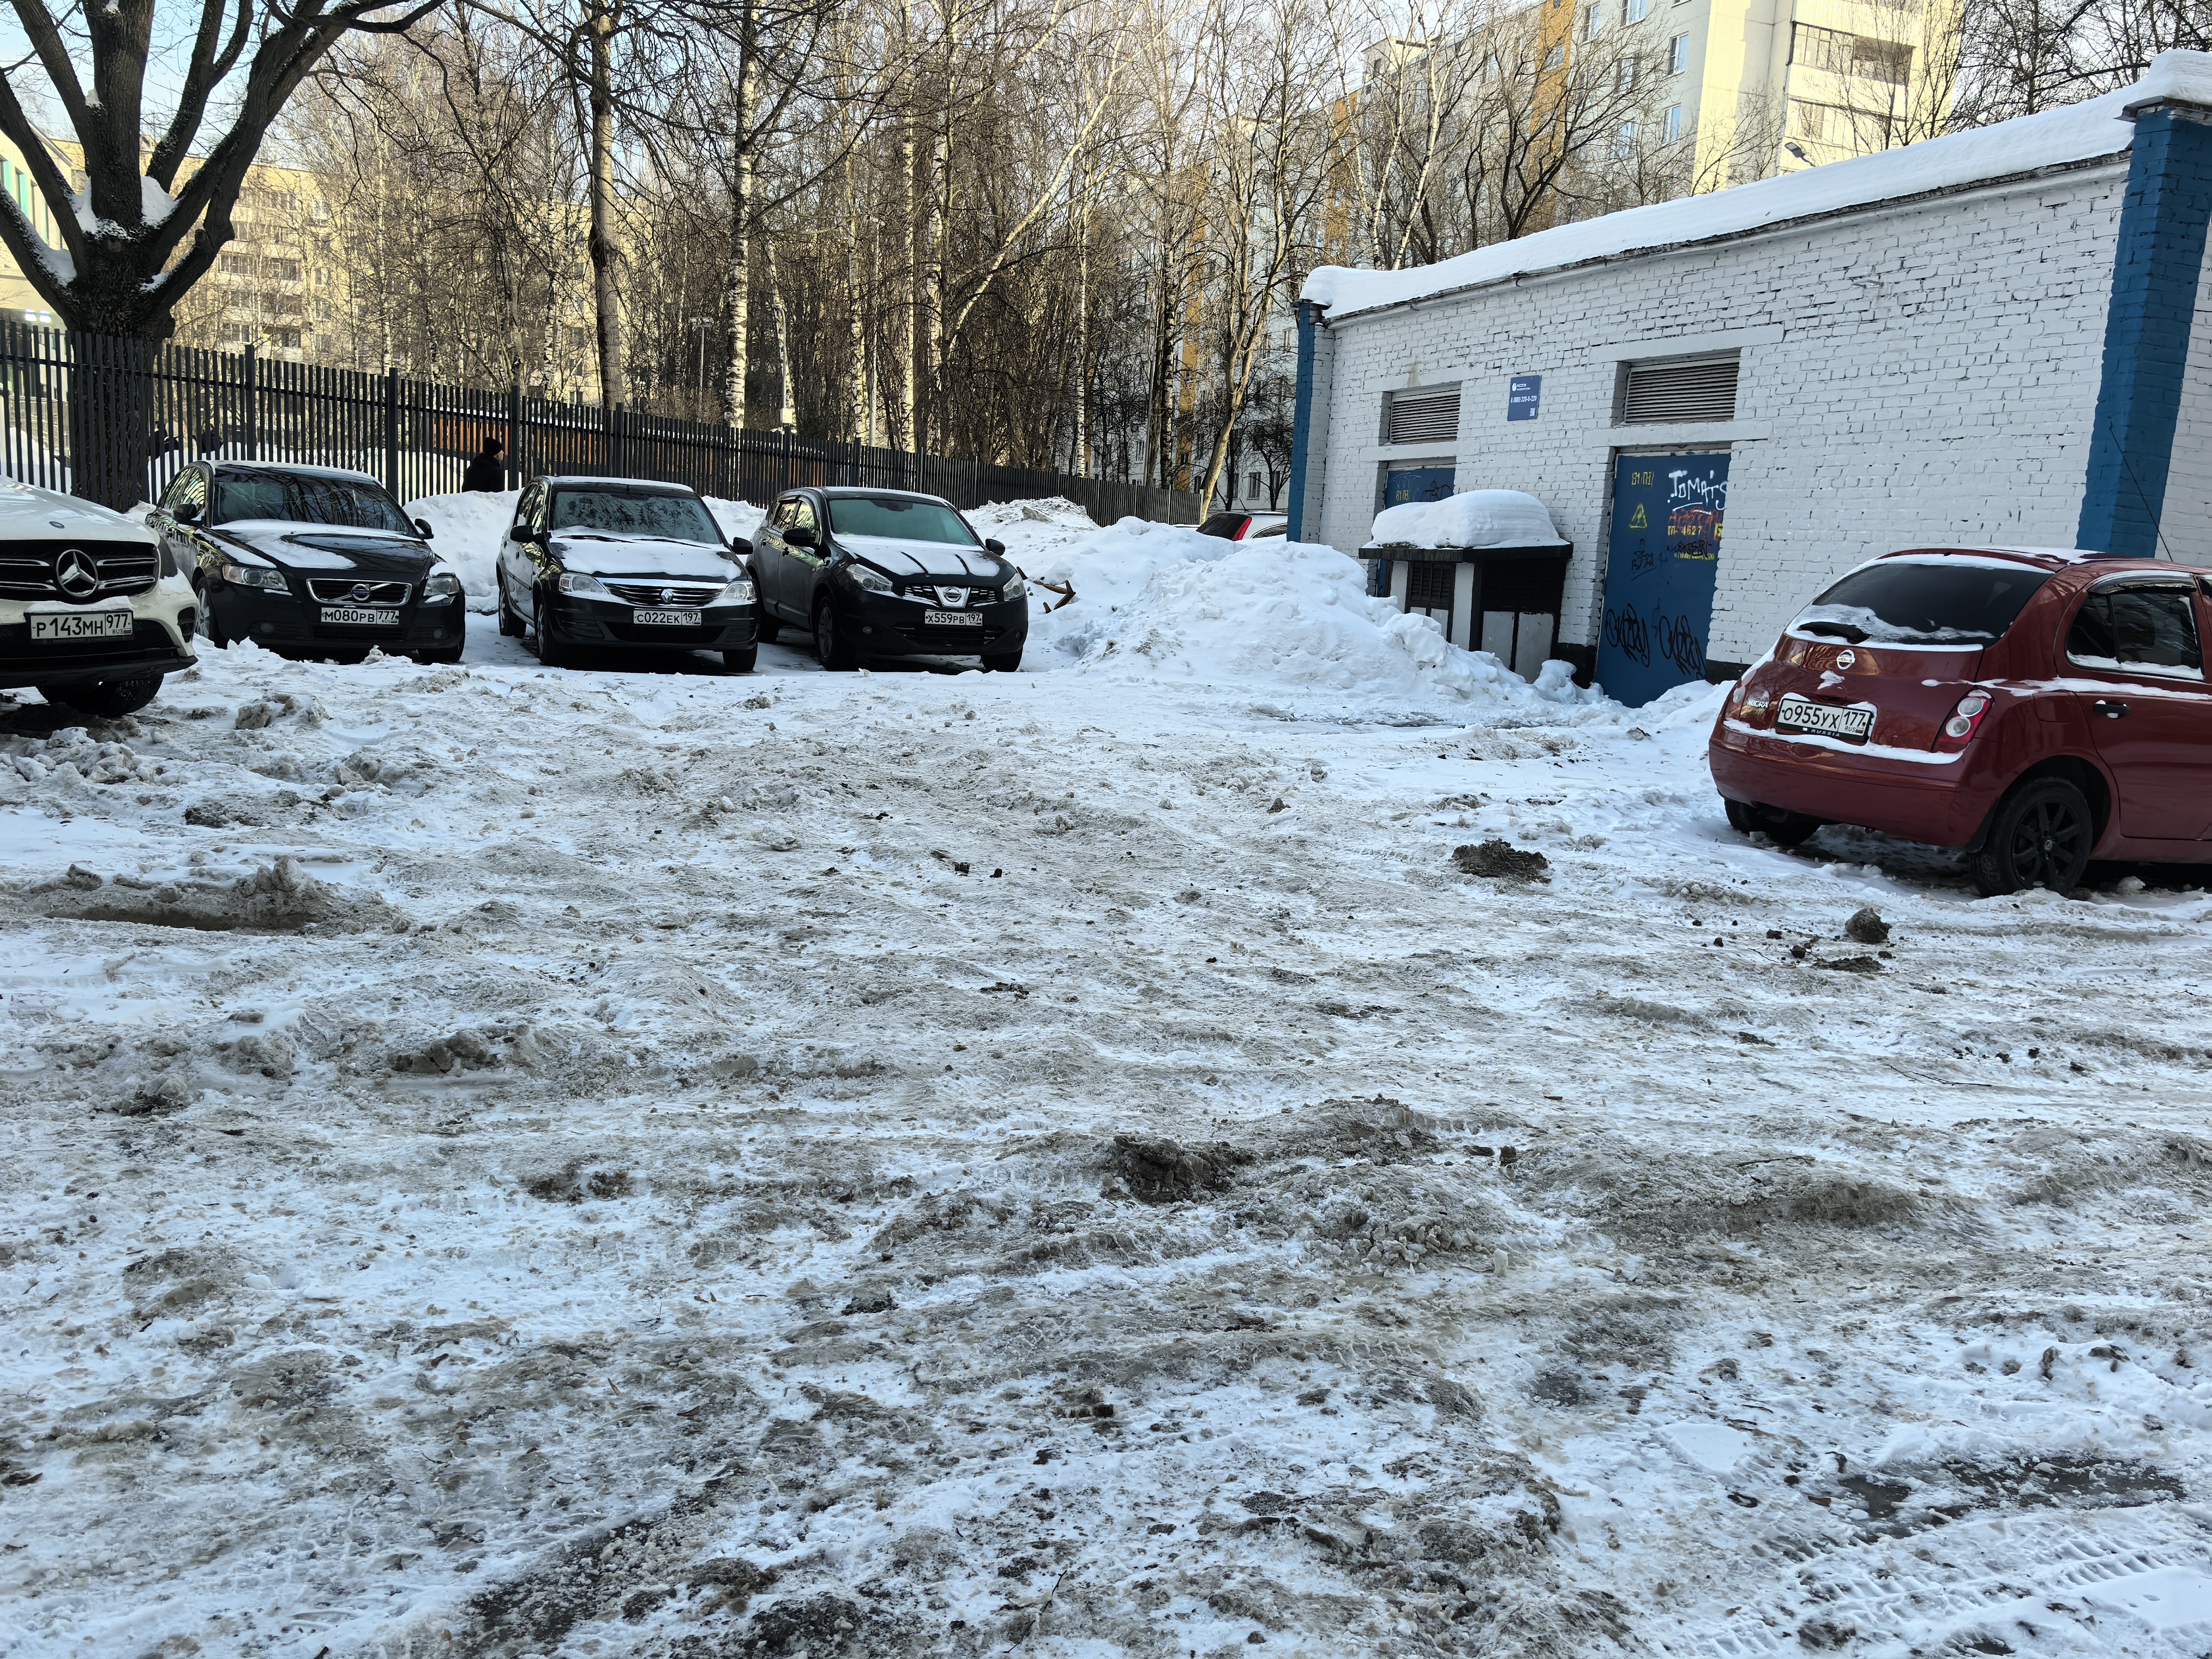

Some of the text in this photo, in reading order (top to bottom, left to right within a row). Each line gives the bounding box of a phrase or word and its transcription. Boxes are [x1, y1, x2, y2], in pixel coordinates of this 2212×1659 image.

[1681, 525, 1703, 536] 4627
[378, 611, 396, 620] 777
[683, 612, 698, 621] 197
[967, 613, 980, 622] 197
[106, 613, 128, 629] 977
[1747, 699, 1768, 708] MICRA
[1844, 711, 1866, 727] 177
[1810, 729, 1840, 737] RUSSIA
